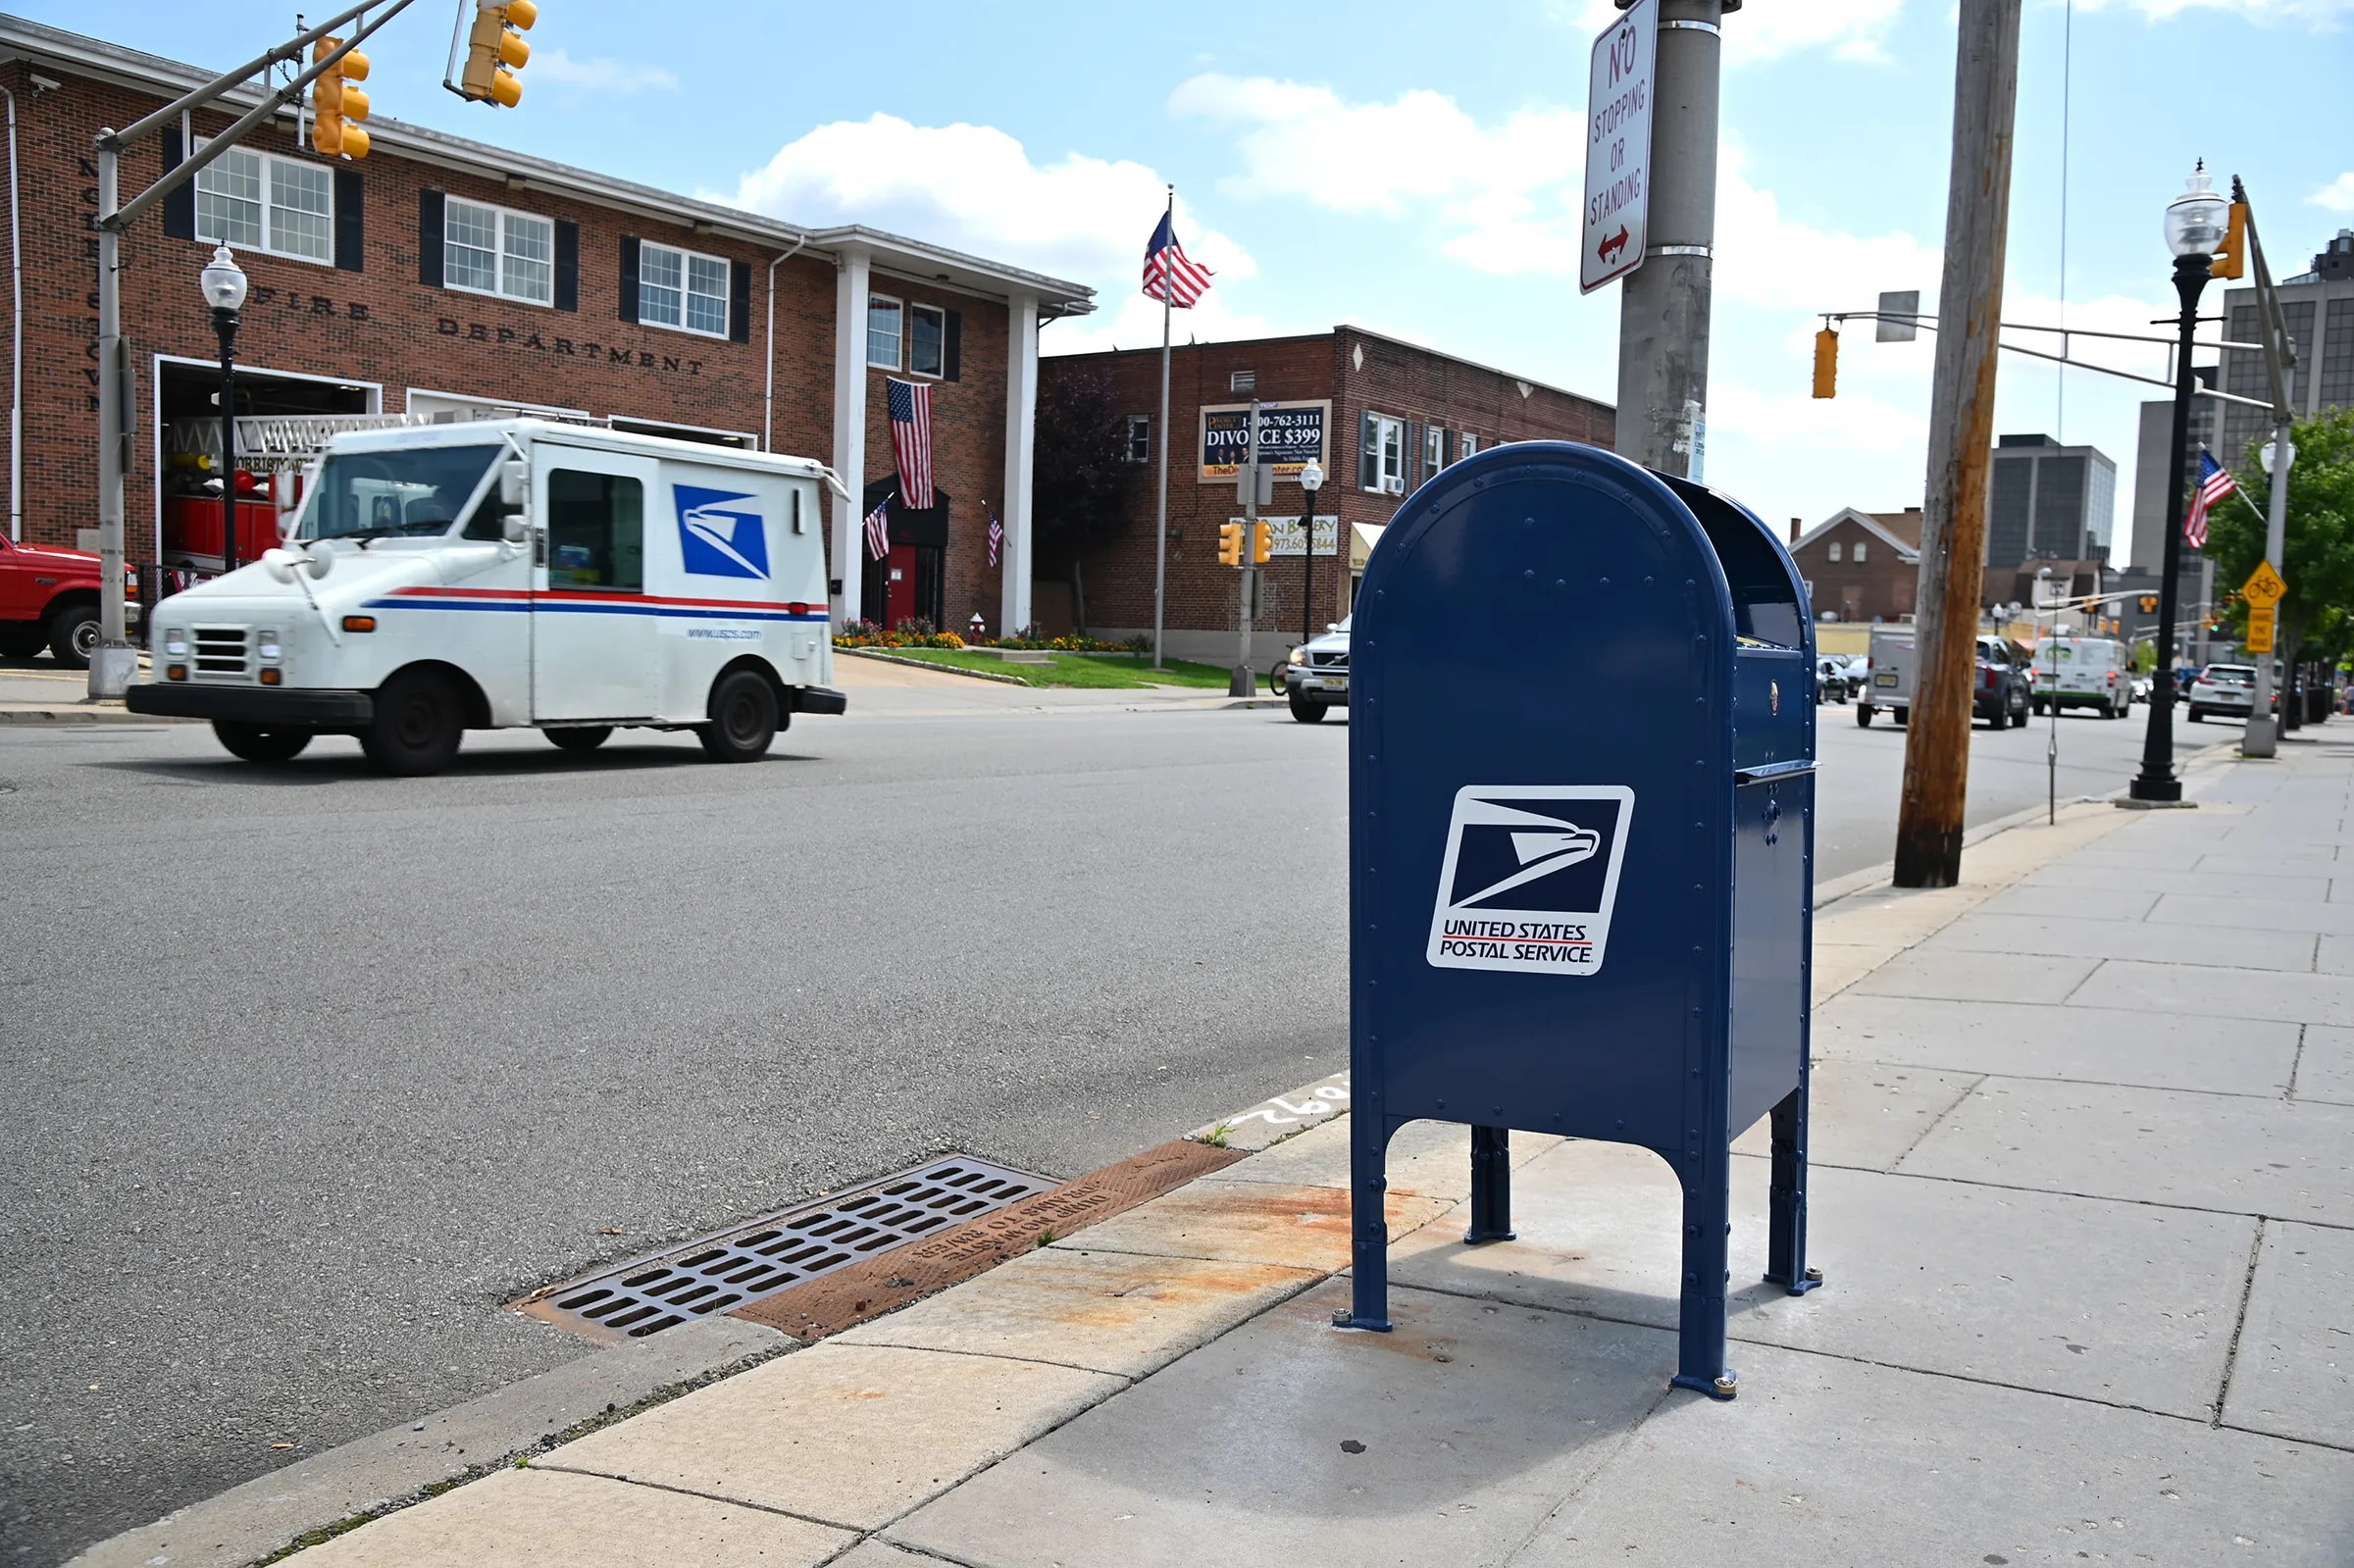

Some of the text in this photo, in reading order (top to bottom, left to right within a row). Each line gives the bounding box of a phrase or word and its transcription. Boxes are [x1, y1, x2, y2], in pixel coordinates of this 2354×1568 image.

[1609, 25, 1637, 89] NO
[1594, 78, 1645, 143] STOPPING
[1610, 137, 1625, 173] OR
[1590, 168, 1641, 226] STANDING
[255, 285, 703, 375] FIRE DEPARTMENT
[1243, 415, 1320, 428] 1-00-762-3111
[1206, 428, 1321, 446] DIVOCE $399
[688, 629, 762, 640] www.usps.com
[1444, 919, 1587, 941] UNITED STATES
[1440, 940, 1510, 959] POSTAL
[1019, 1182, 1100, 1216] DRAINS
[1057, 1194, 1111, 1218] DUMP
[988, 1216, 1024, 1230] TO
[1021, 1216, 1056, 1232] NO
